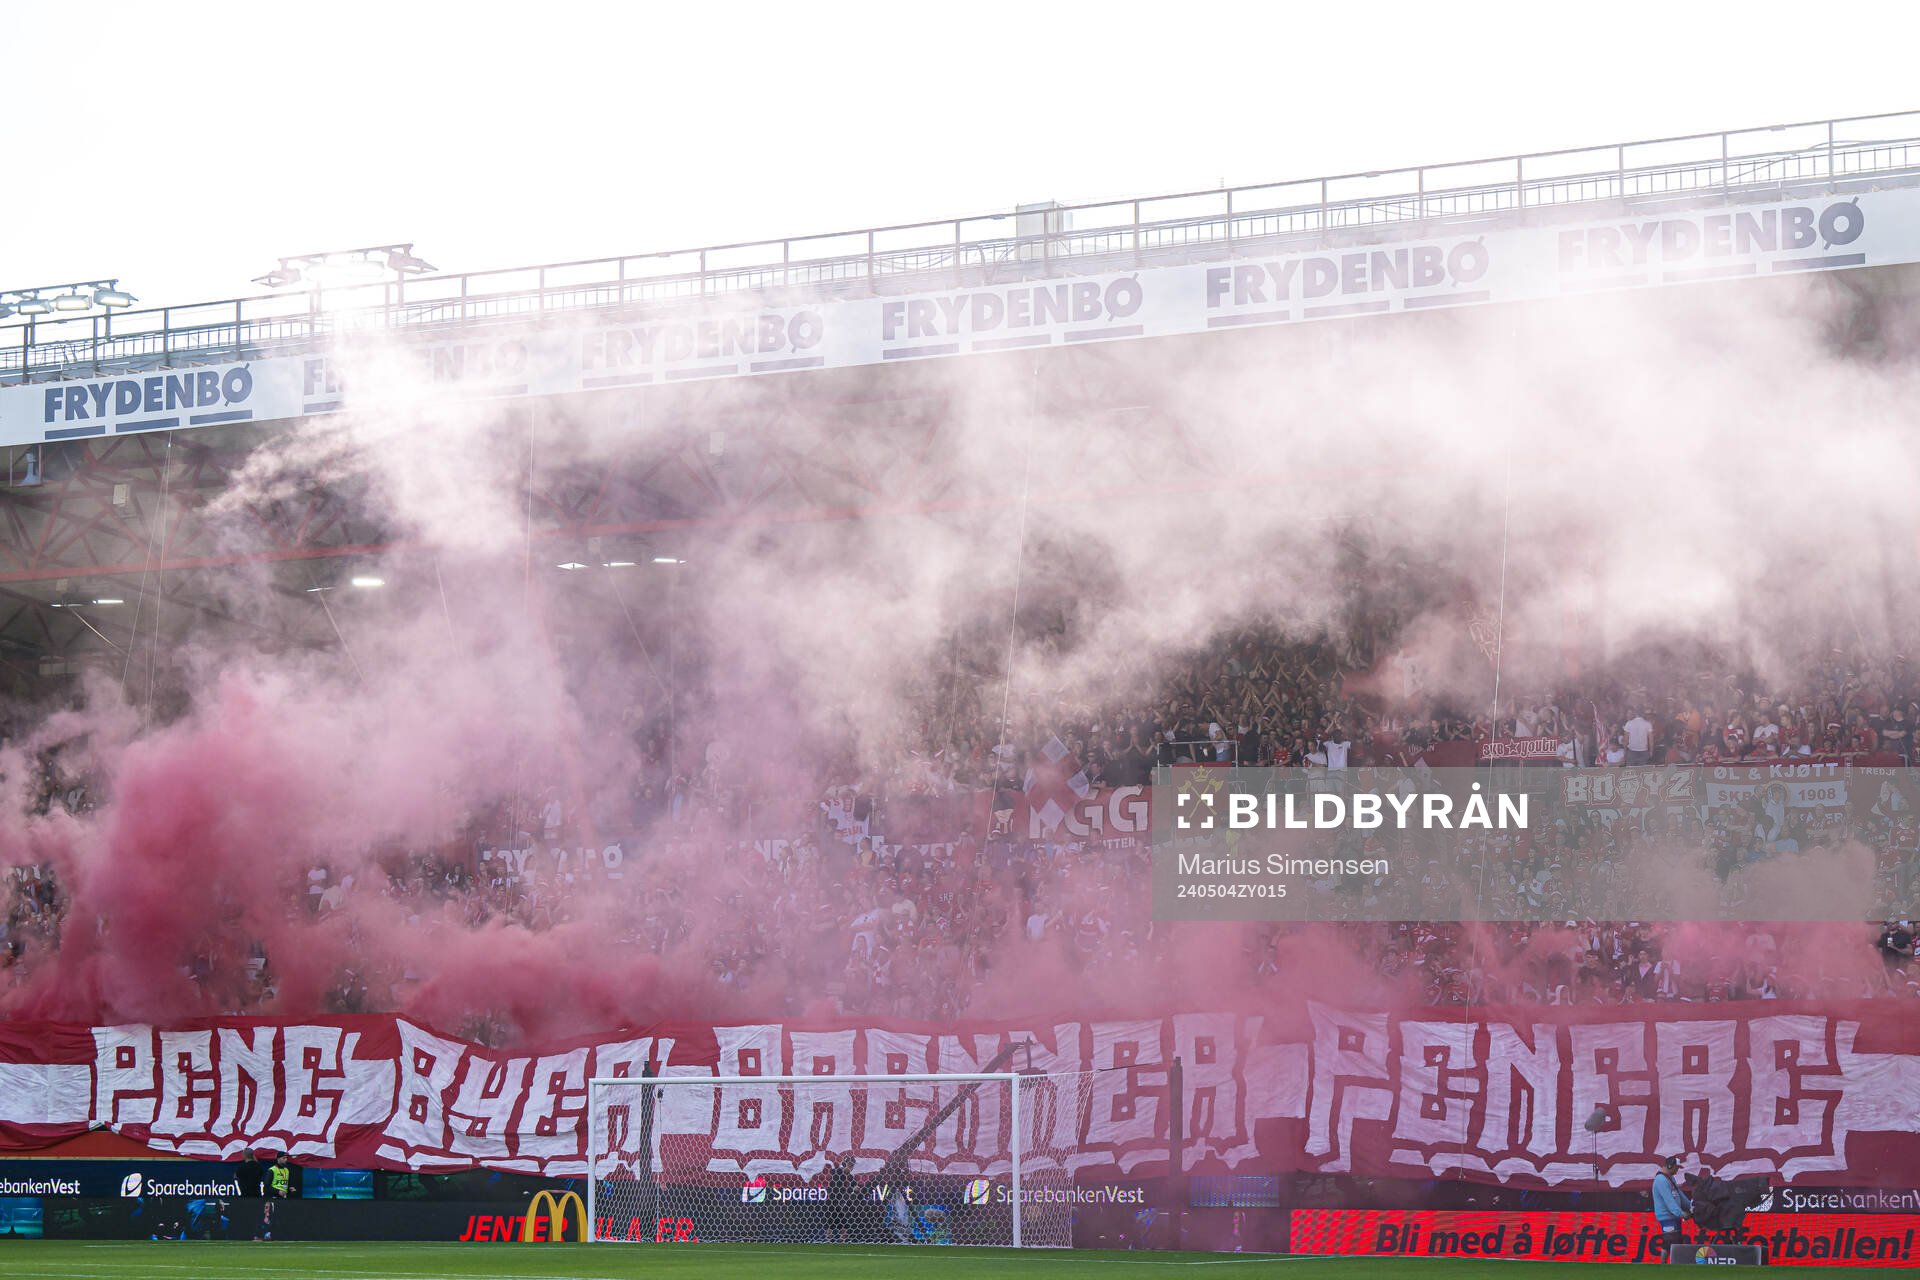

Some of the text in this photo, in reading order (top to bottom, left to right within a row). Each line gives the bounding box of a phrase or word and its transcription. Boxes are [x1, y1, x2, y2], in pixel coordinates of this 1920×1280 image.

[1558, 196, 1864, 272] FRYDENBØ
[1207, 236, 1489, 309] FRYDENBØ
[583, 304, 823, 370] FRYDENBØ
[882, 272, 1143, 342] FRYDENBØ
[45, 363, 253, 423] FRYDENBØ
[1714, 763, 1839, 781] ØL & KJØTT
[1798, 788, 1837, 801] 1908
[92, 1024, 360, 1160] PENE
[1306, 1001, 1861, 1187] PENERE
[996, 1185, 1144, 1205] SparebankenVest
[1375, 1222, 1422, 1253] Bli
[1427, 1224, 1506, 1254] med
[1512, 1223, 1533, 1256] å
[1543, 1224, 1628, 1257] løfte
